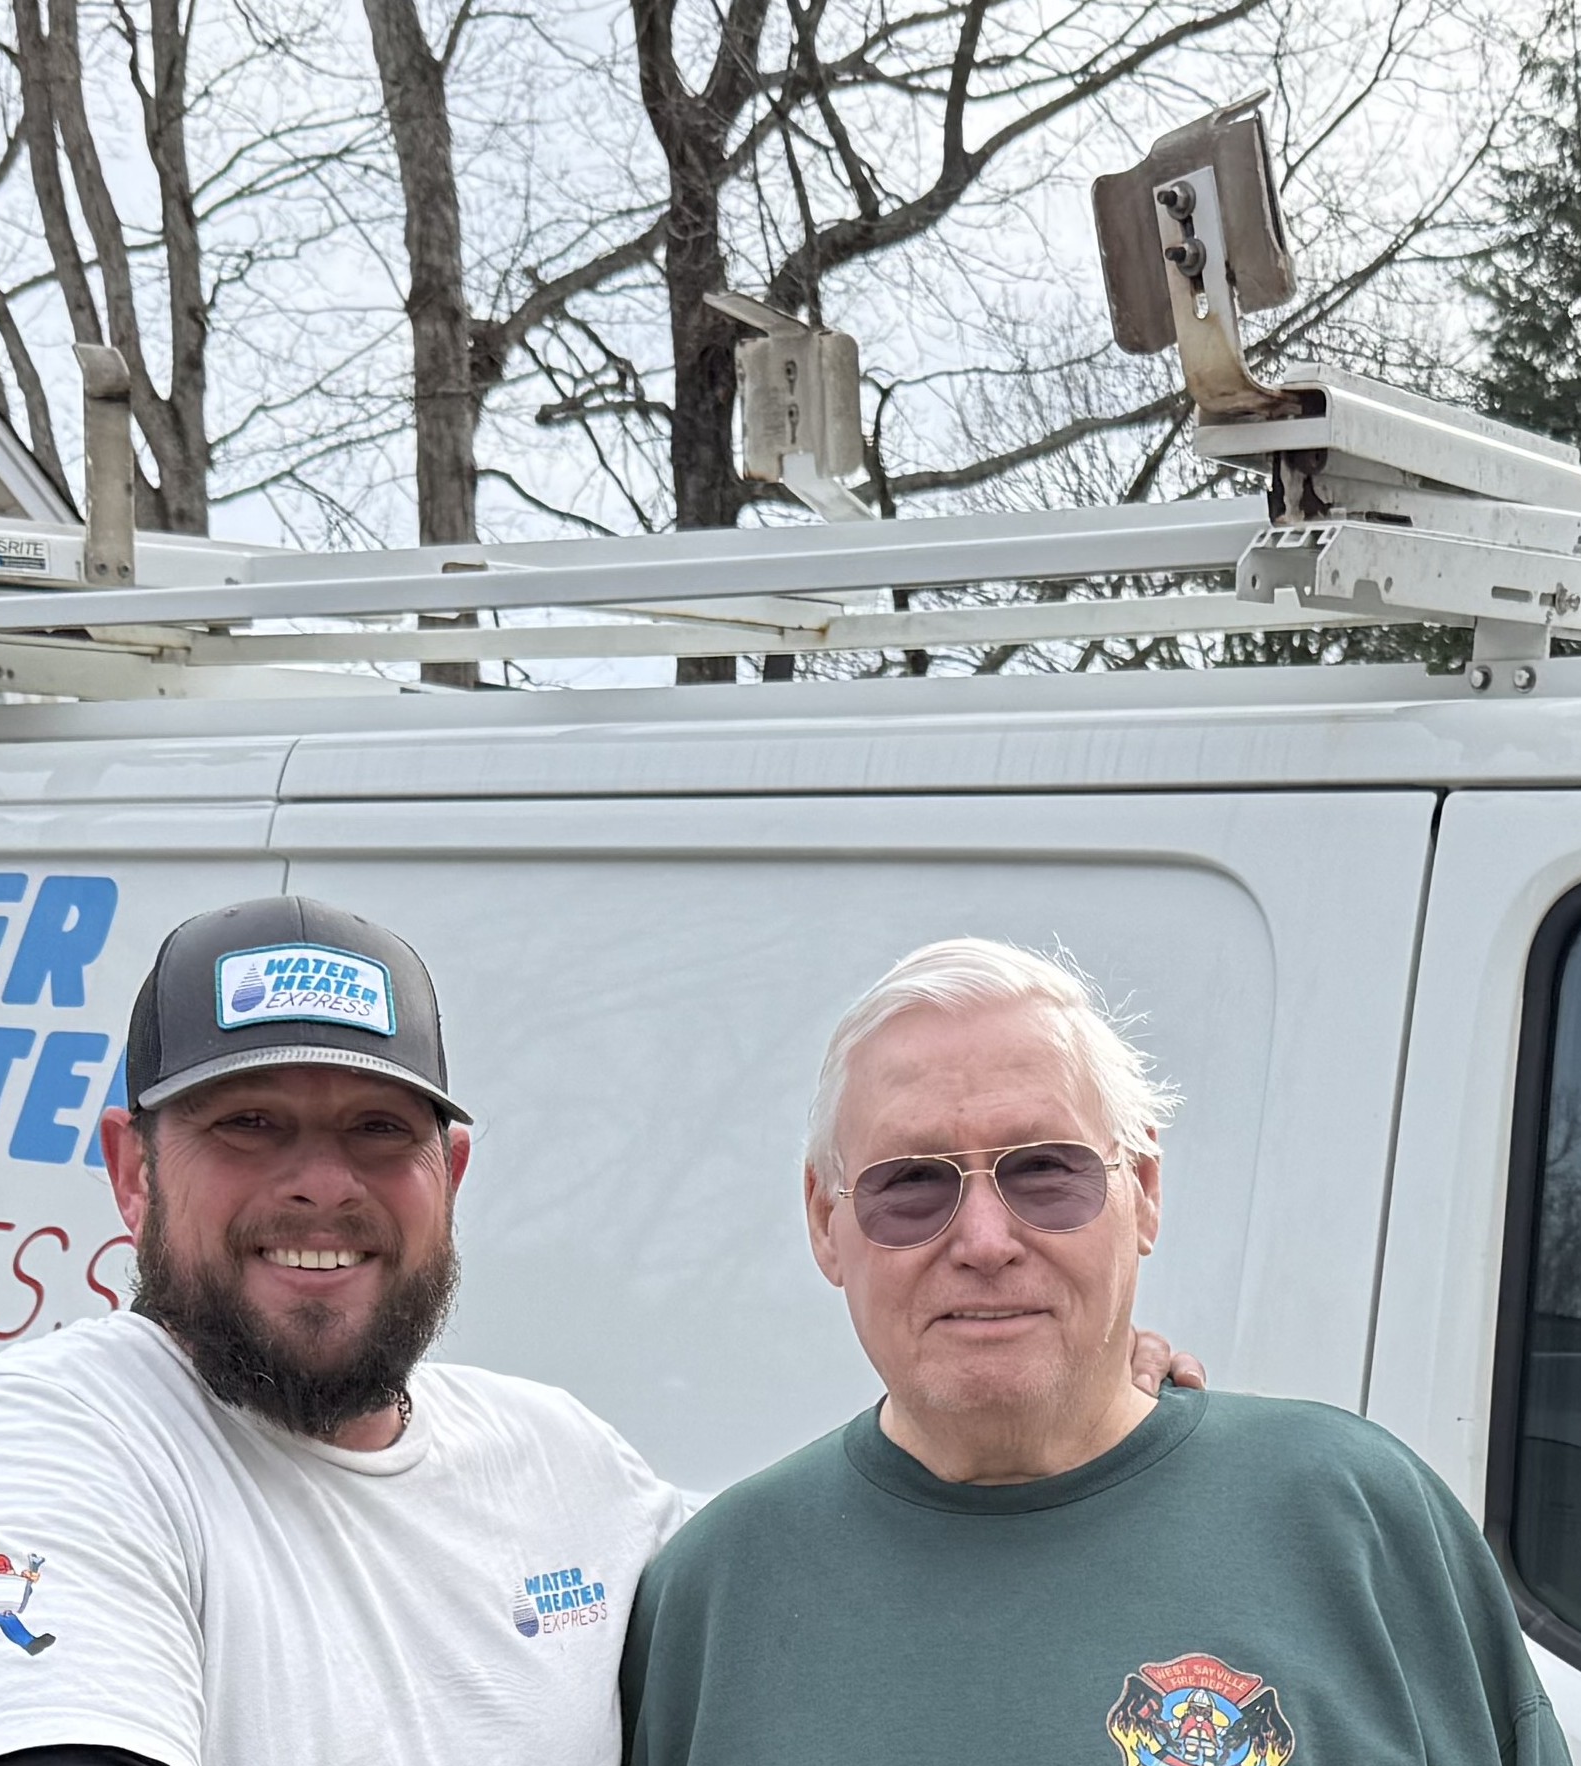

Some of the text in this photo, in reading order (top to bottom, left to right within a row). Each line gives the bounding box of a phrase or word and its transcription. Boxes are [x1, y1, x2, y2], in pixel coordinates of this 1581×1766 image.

[264, 957, 359, 981] WATER
[271, 975, 377, 1005] HEATER
[265, 991, 374, 1017] EXPRESS
[524, 1567, 583, 1595] WATER
[535, 1582, 605, 1614] HEATER
[543, 1602, 607, 1634] EXPRESS
[1155, 1664, 1249, 1690] WEST SAYVILLE
[1170, 1676, 1196, 1687] FIRE
